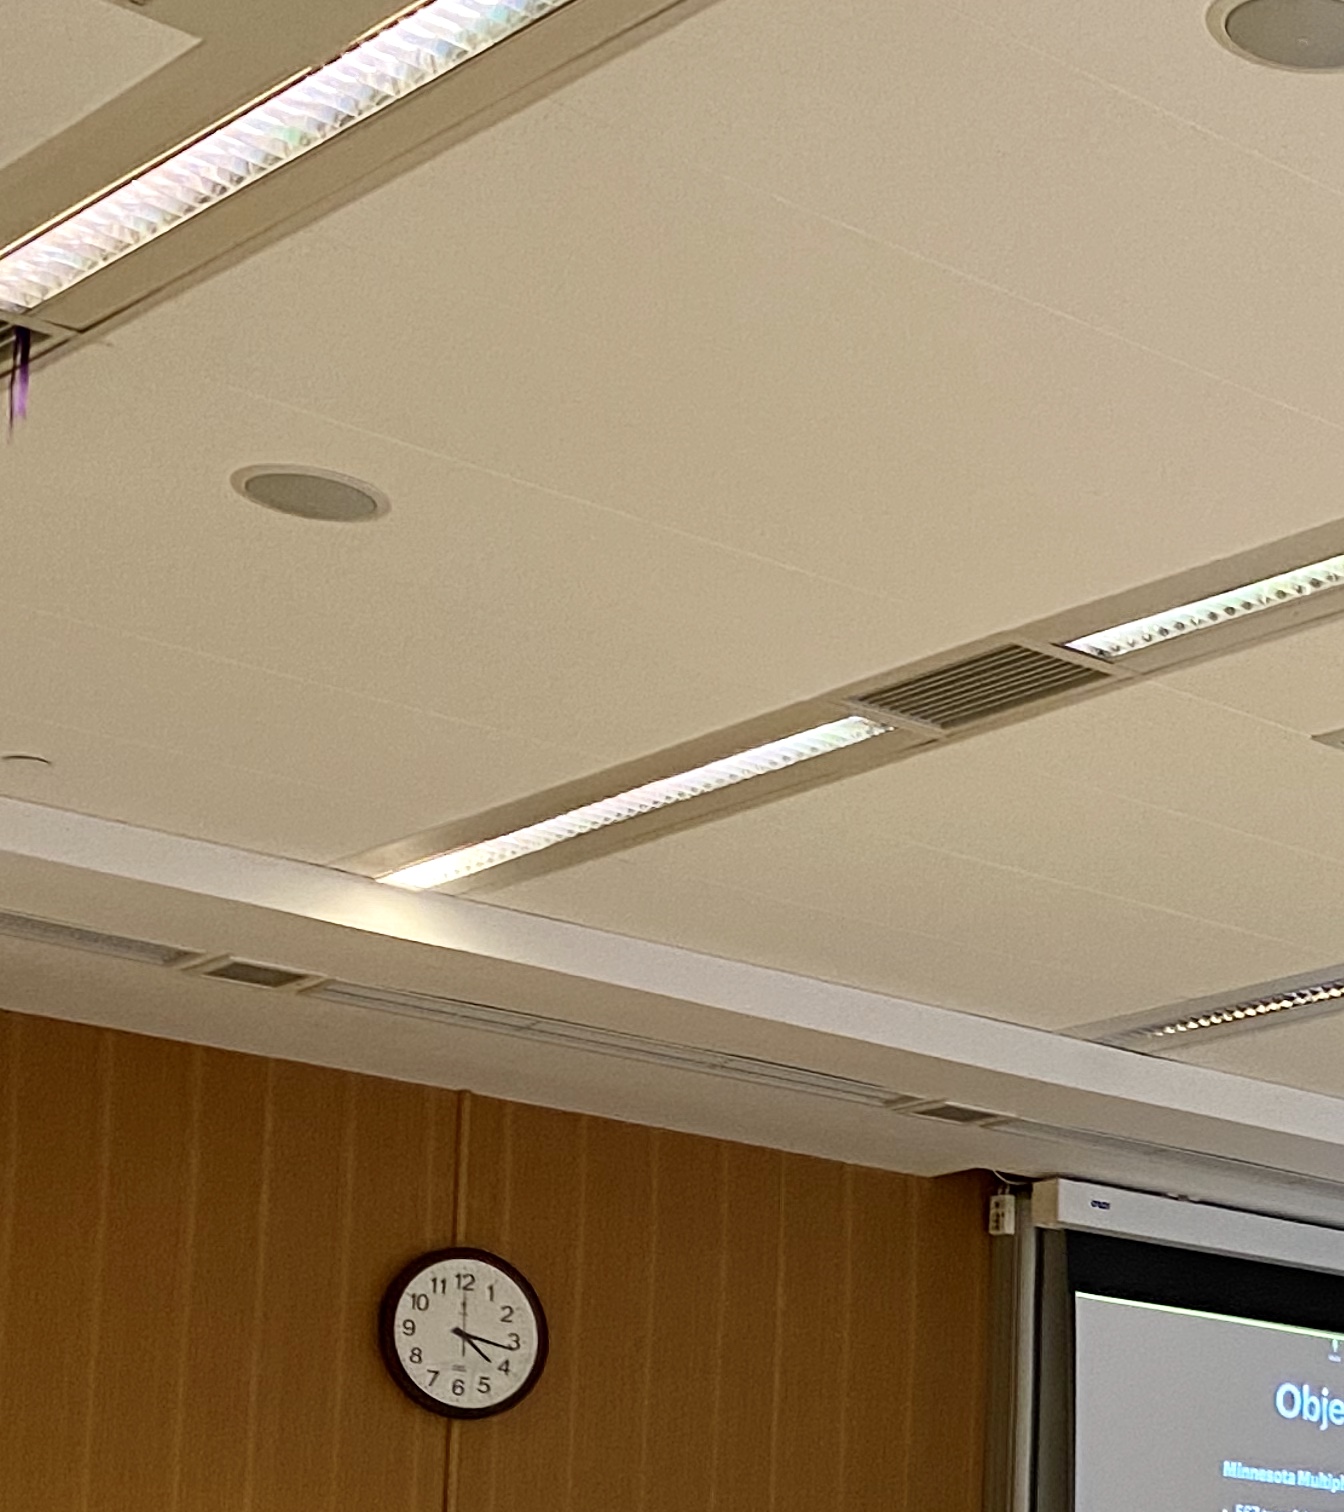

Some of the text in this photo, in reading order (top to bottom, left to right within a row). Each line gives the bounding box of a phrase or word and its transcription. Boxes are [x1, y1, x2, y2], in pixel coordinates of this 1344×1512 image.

[431, 1277, 447, 1295] 11
[454, 1273, 476, 1291] 12
[411, 1292, 429, 1311] 10
[488, 1284, 495, 1302] 1
[500, 1305, 514, 1323] 2
[402, 1318, 416, 1336] 9
[507, 1332, 521, 1351] 3
[409, 1347, 422, 1364] 8
[497, 1359, 511, 1375] 4
[427, 1369, 440, 1387] 7
[477, 1376, 491, 1394] 5
[452, 1379, 465, 1396] 6
[1223, 1461, 1297, 1486] Minnesota
